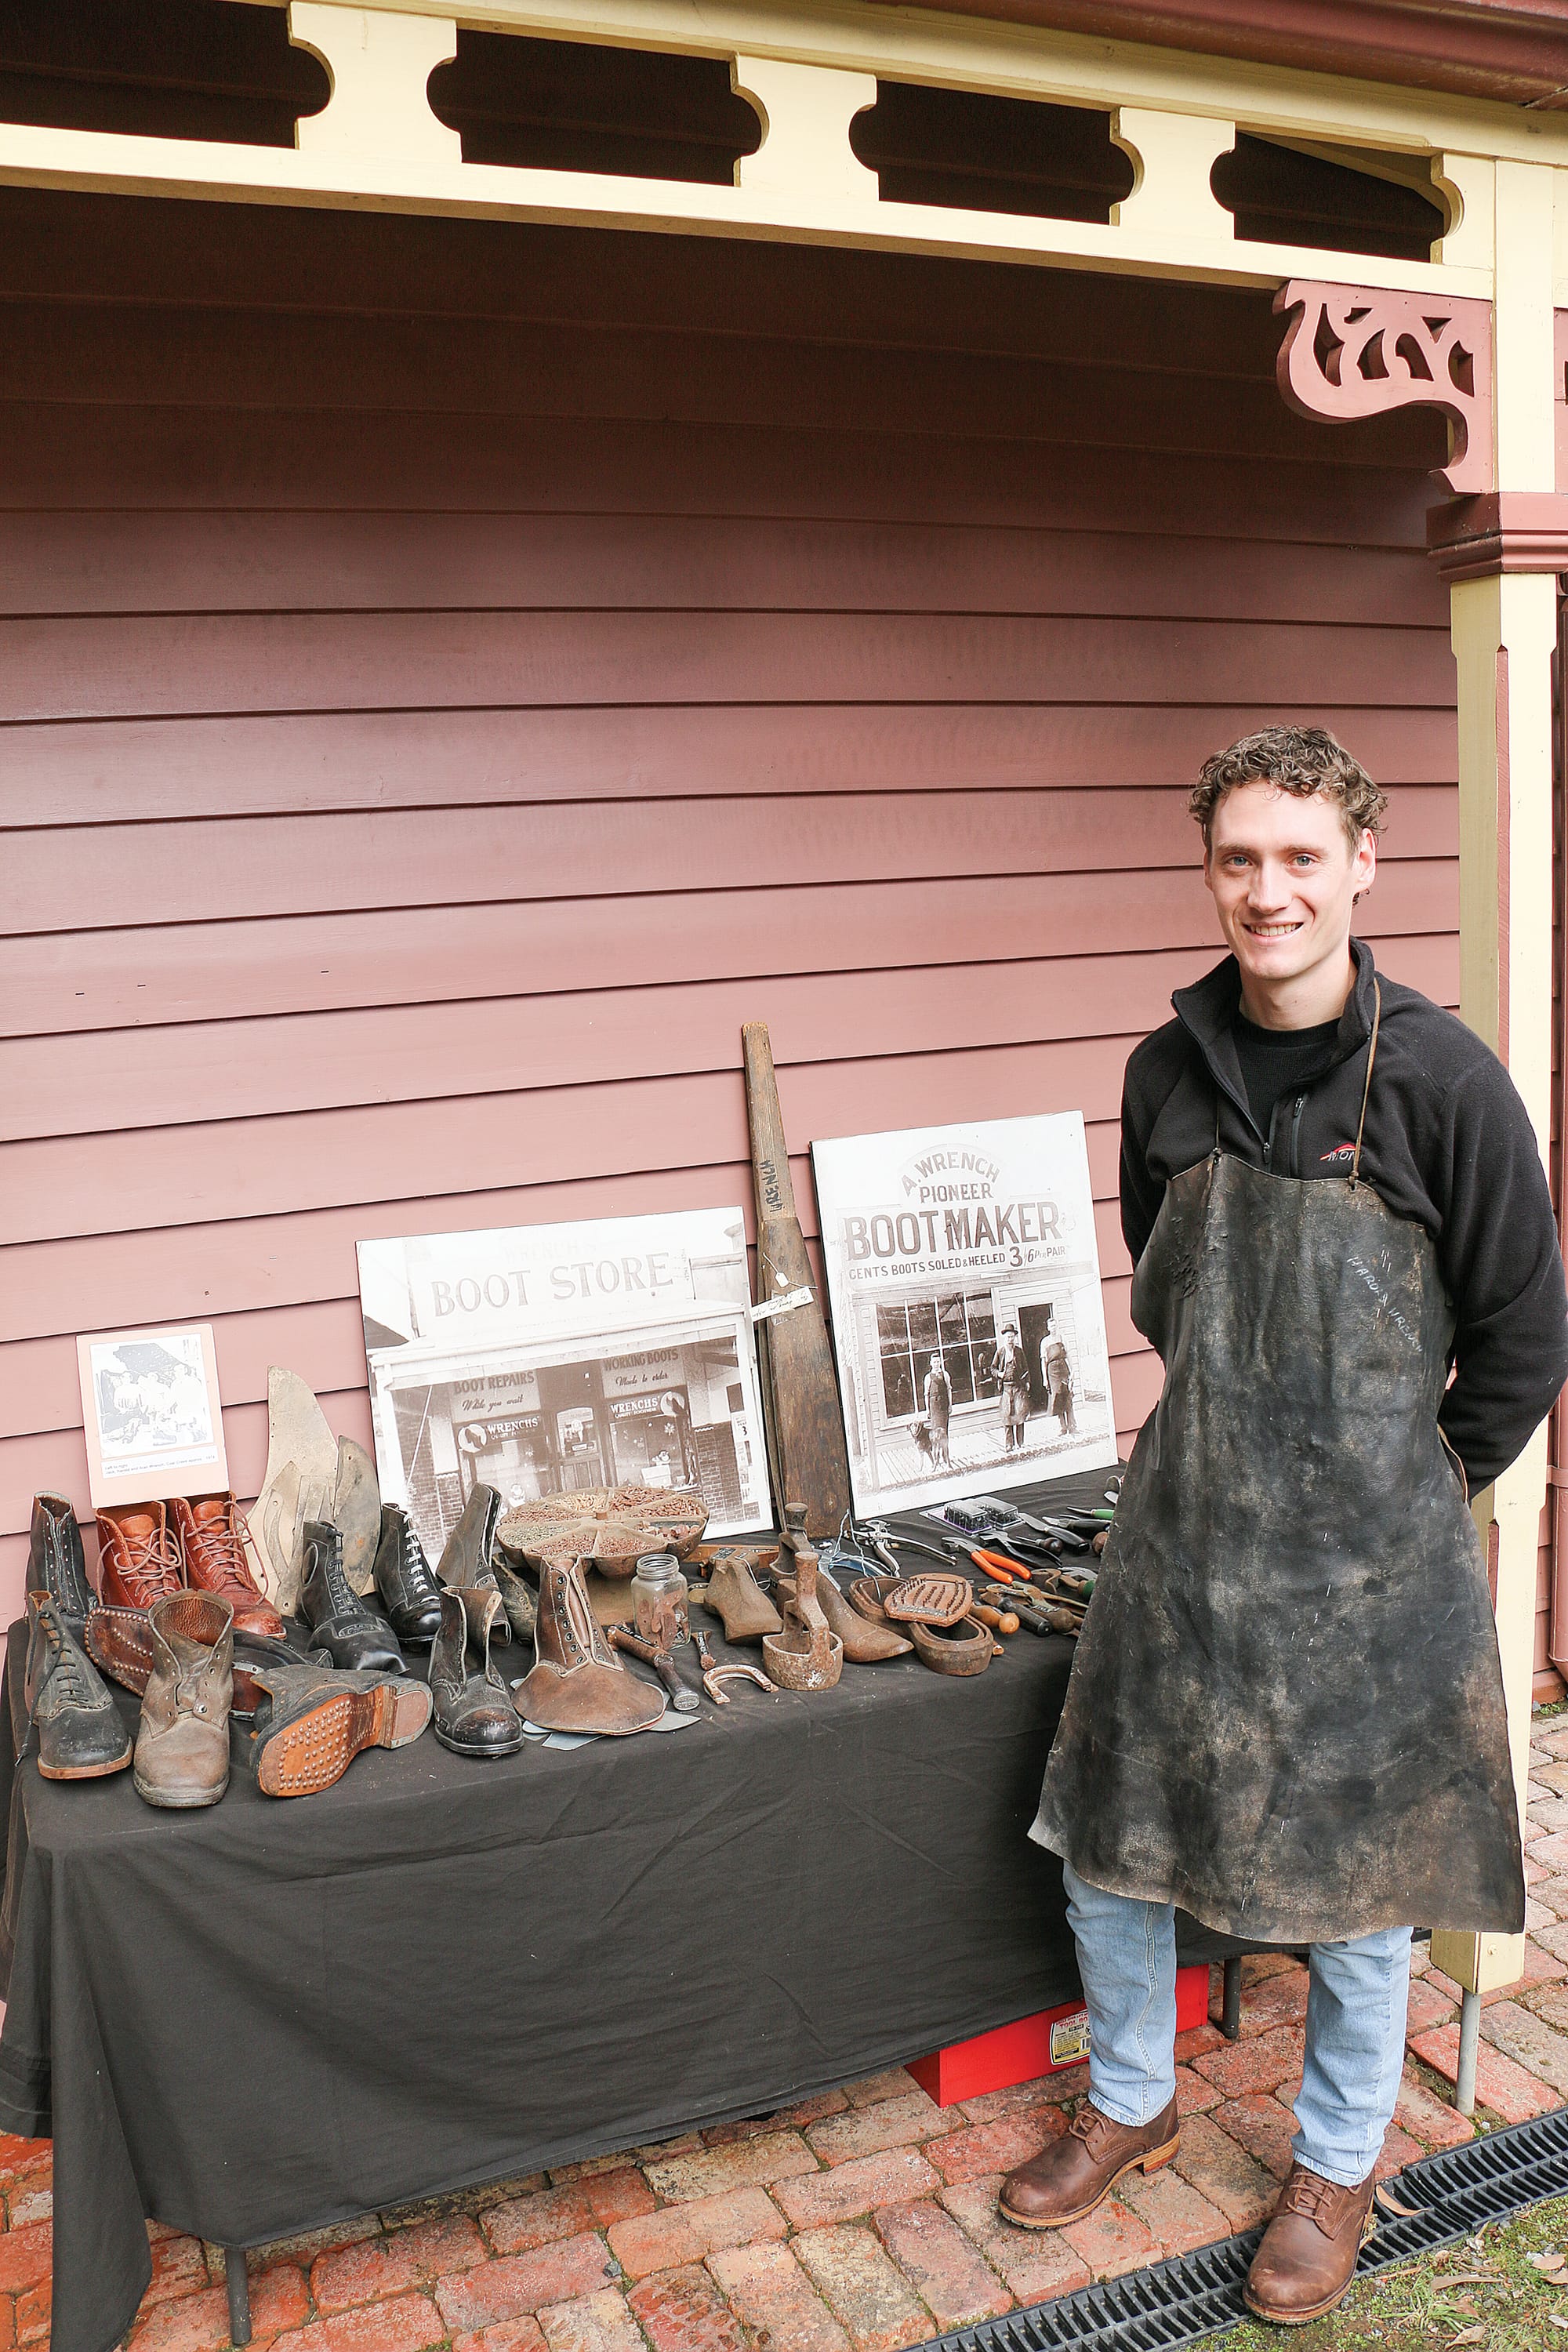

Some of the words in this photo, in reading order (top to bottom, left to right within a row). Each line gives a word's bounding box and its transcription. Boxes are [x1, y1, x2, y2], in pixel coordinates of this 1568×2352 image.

[1328, 1150, 1363, 1161] MON
[902, 1174, 922, 1197] A.
[914, 1151, 1000, 1183] WRENCH
[919, 1182, 994, 1203] PIONEER
[891, 1261, 926, 1276] BOOTS
[928, 1258, 962, 1271] SOLED
[968, 1253, 1005, 1266] HEELED
[1046, 1246, 1066, 1256] PAIR
[430, 1270, 530, 1317] BOOT
[550, 1253, 673, 1300] STORE
[603, 1353, 645, 1371] WORKING
[647, 1348, 679, 1365] BOOTS
[453, 1377, 485, 1394] BOOT
[488, 1371, 535, 1389] REPAIRS
[615, 1375, 637, 1386] Made
[642, 1374, 648, 1382] to
[652, 1370, 668, 1381] order
[462, 1399, 485, 1411] While
[487, 1401, 502, 1412] you
[506, 1394, 524, 1405] wait
